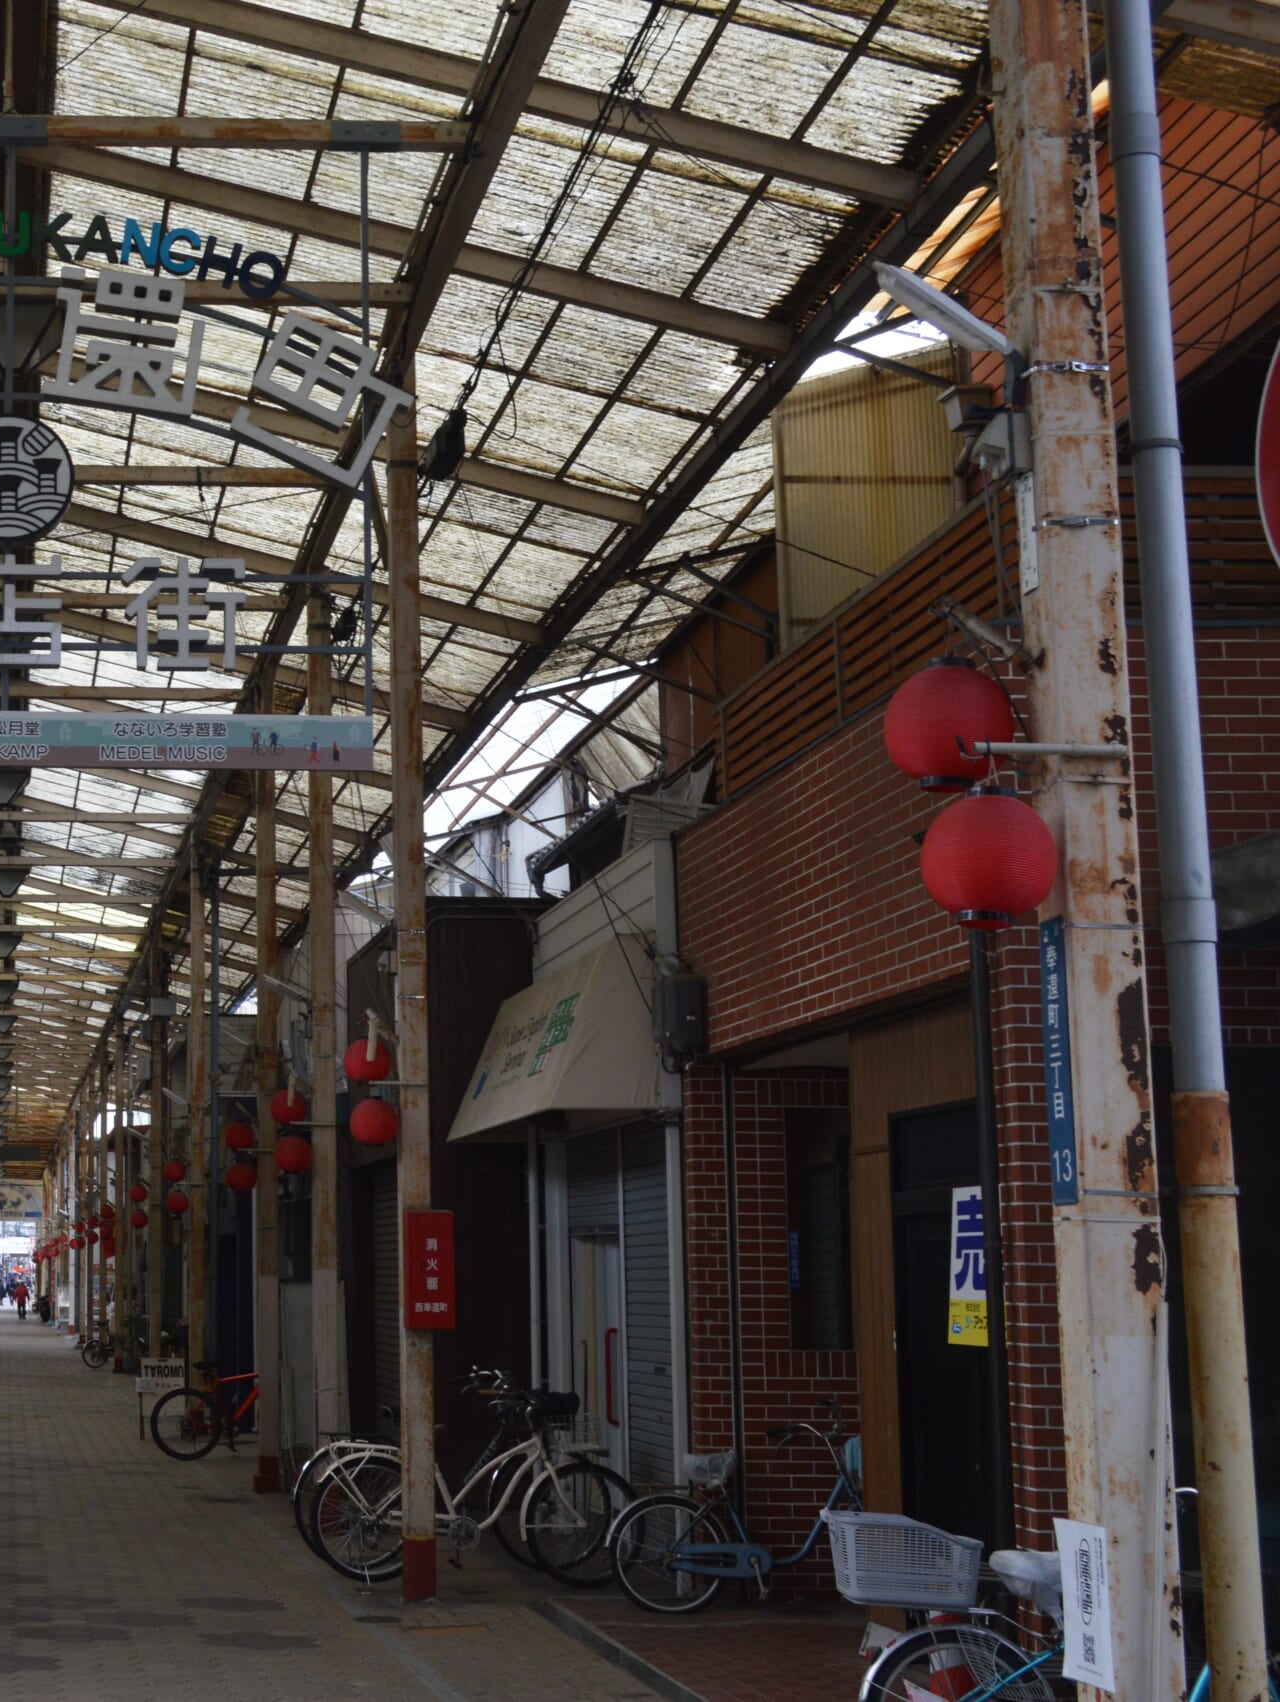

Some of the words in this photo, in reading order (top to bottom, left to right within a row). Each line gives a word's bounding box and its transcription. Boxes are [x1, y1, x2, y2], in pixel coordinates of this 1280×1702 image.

[113, 720, 228, 738] なないろ学習塾
[99, 745, 163, 761] MEDEL
[167, 745, 228, 762] MUSIC
[1053, 1148, 1073, 1185] 13
[425, 1237, 439, 1291] 消火器
